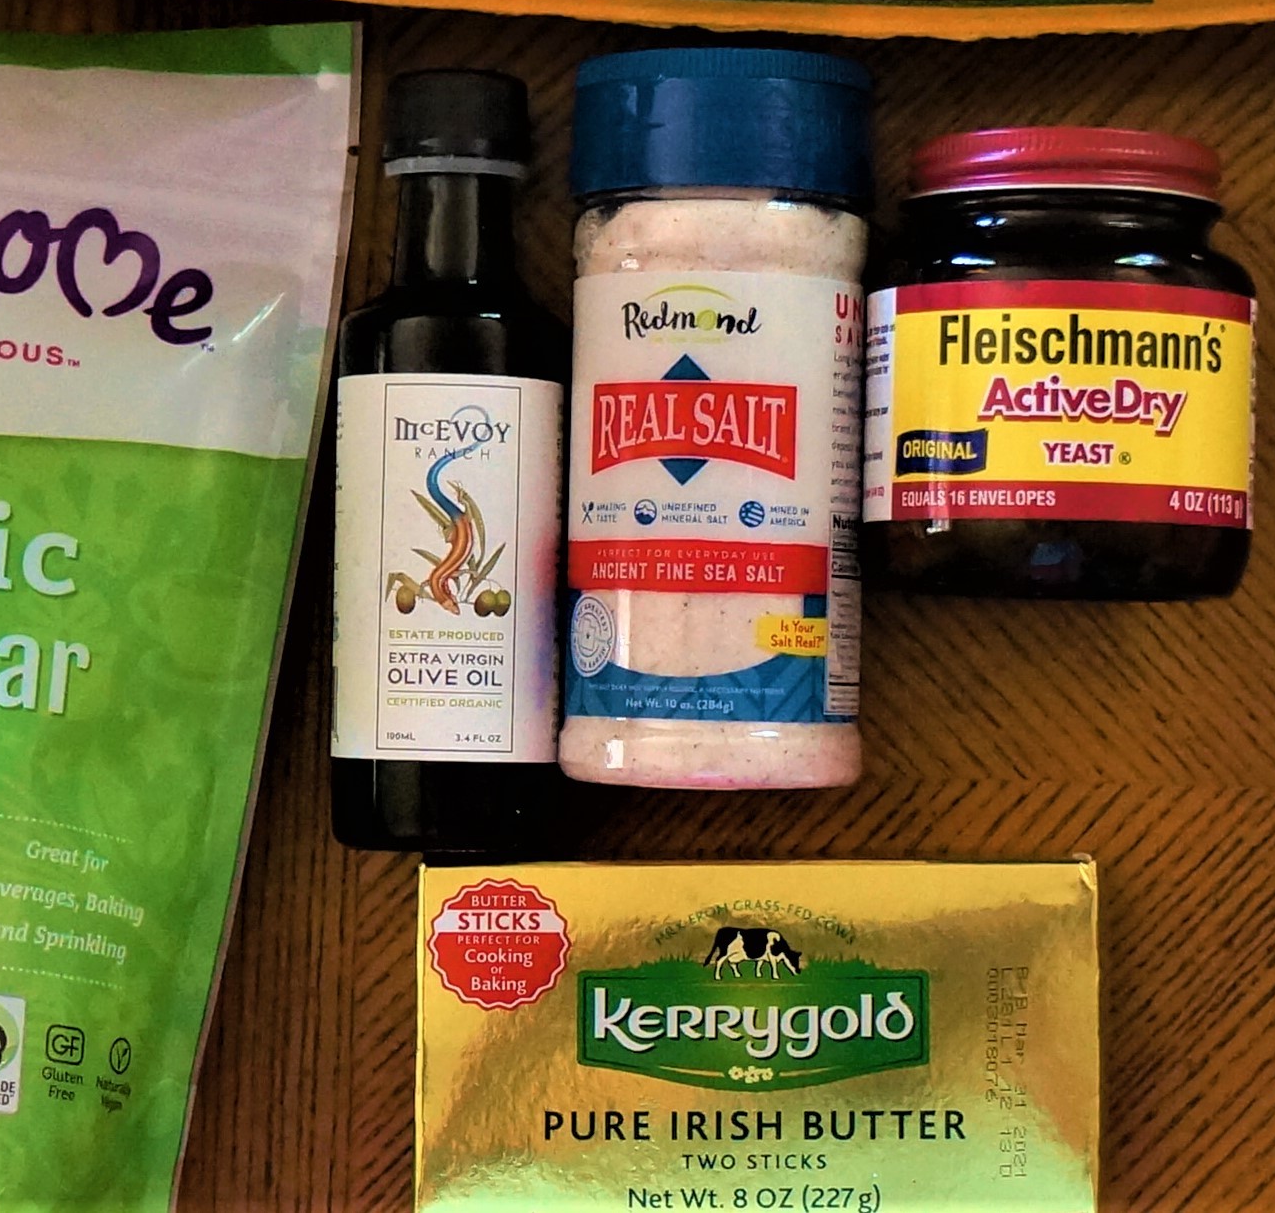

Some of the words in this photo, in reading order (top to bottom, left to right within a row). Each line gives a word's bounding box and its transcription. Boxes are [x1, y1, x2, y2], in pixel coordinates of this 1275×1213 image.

[938, 312, 1222, 373] Fleischmann's
[598, 393, 686, 460] REAL
[692, 393, 786, 460] SALT
[415, 447, 491, 460] RANCH
[901, 437, 977, 460] ORIGINAL
[1043, 441, 1114, 465] YEAST
[901, 489, 946, 507] EQUALS
[949, 490, 966, 506] 16
[969, 490, 1056, 507] ENVELOPES
[592, 562, 648, 579] ANCIENT
[656, 563, 694, 580] FINE
[704, 564, 737, 581] SEA
[746, 565, 785, 583] SALT
[389, 629, 435, 640] ESTATE
[438, 630, 504, 641] PRODUCED
[793, 620, 815, 634] Your
[770, 635, 792, 648] Salt
[389, 652, 442, 665] EXTRA
[448, 653, 504, 666] VIRGIN
[388, 668, 458, 685] OLIVE
[467, 670, 503, 687] OIL
[387, 698, 445, 707] CERTIFIED
[449, 699, 502, 709] ORGANIC
[26, 840, 79, 868] Great
[84, 891, 145, 928] Baking
[472, 895, 527, 907] BUTTER
[458, 912, 540, 930] STICKS
[34, 924, 128, 965] Sprinkling
[458, 935, 509, 944] PERFECT
[515, 935, 540, 944] FOR
[464, 948, 533, 967] Cooking
[491, 966, 503, 974] or
[471, 977, 527, 995] Baking
[592, 987, 916, 1059] Kerrygold
[544, 1110, 651, 1141] PURE
[671, 1110, 783, 1141] IRISH
[802, 1110, 966, 1141] BUTTER
[682, 1154, 735, 1170] TWO
[747, 1154, 827, 1170] STICKS
[628, 1188, 673, 1210] Net
[681, 1188, 724, 1210] Wt.
[756, 1188, 793, 1209] OZ
